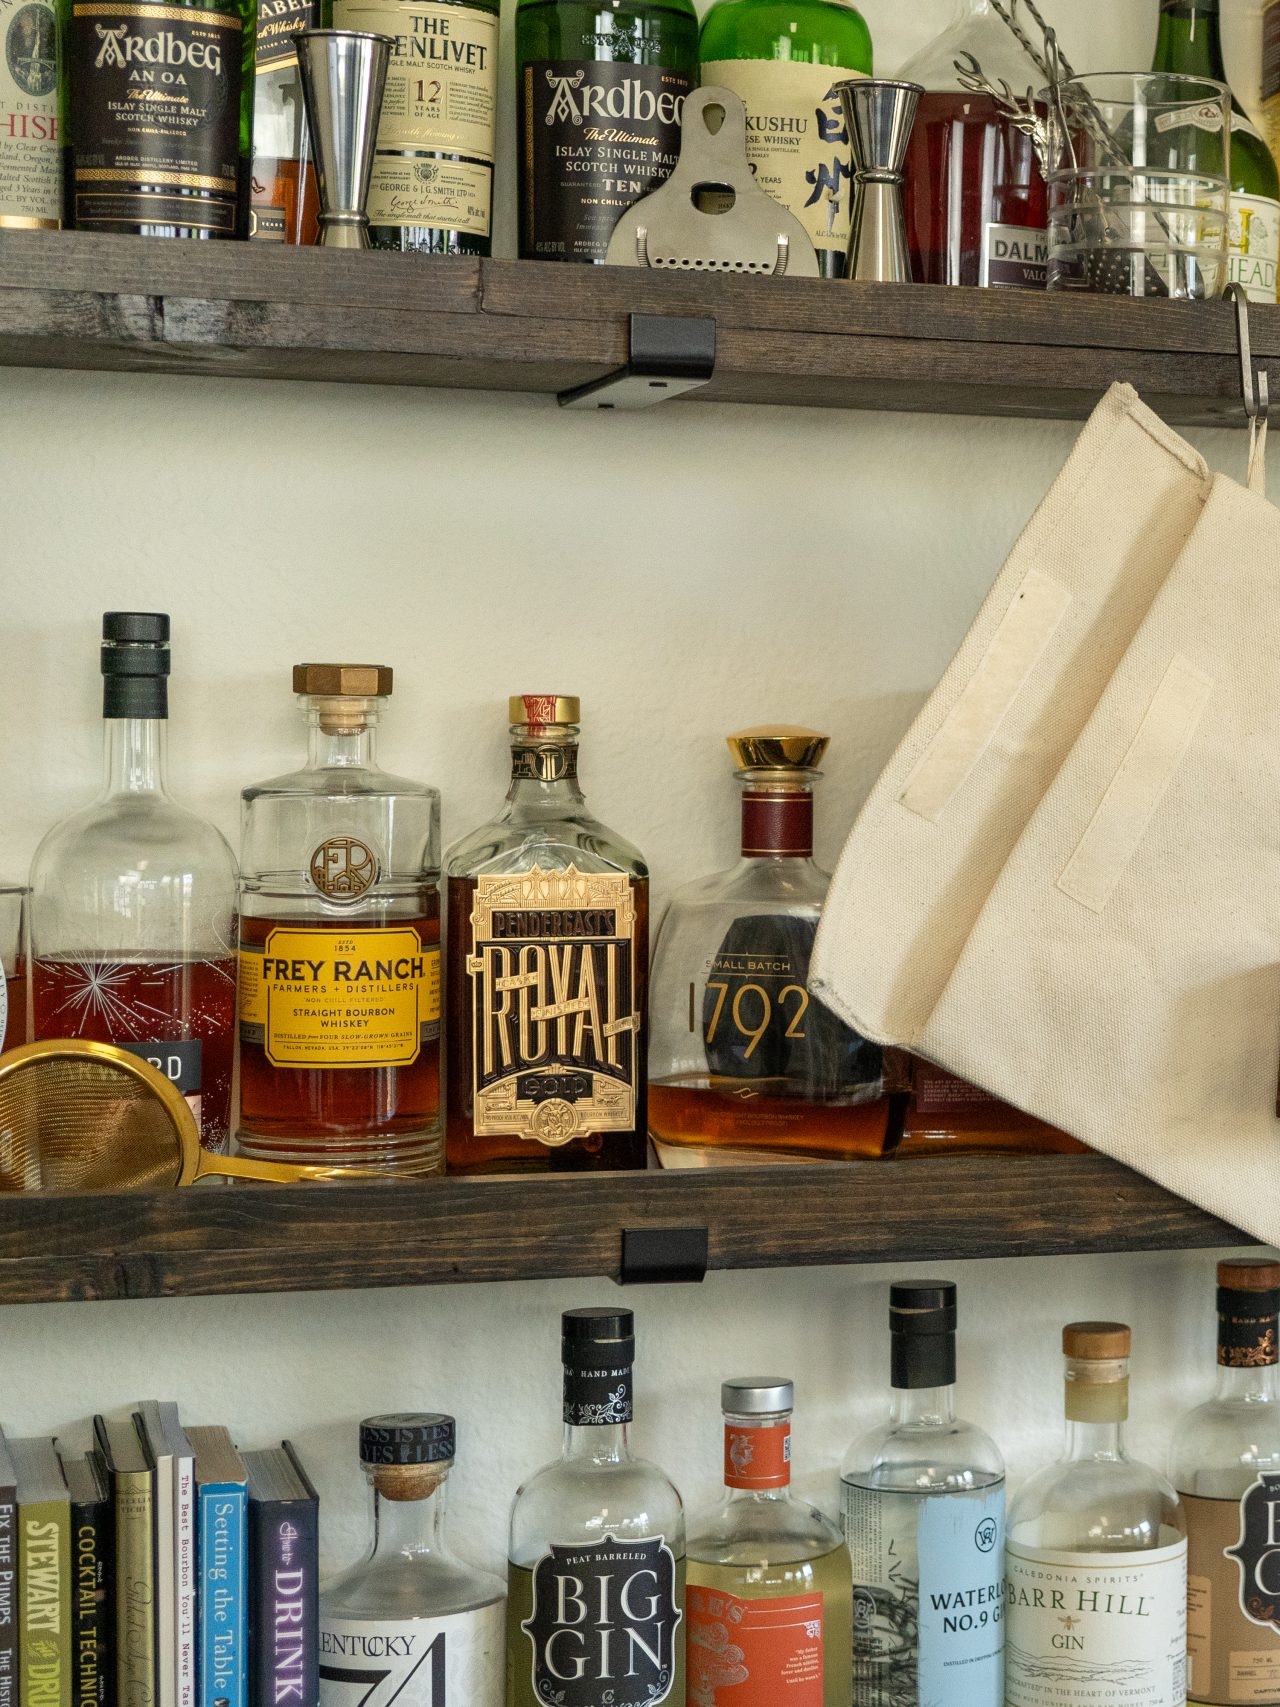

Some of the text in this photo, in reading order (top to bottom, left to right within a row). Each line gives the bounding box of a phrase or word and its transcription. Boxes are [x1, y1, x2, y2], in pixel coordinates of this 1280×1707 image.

[257, 0, 314, 17] ABEL
[409, 16, 450, 36] THE
[129, 70, 187, 85] AN OA
[427, 63, 453, 72] SCOTCH
[454, 66, 476, 75] WHISKY
[415, 79, 443, 104] 12
[108, 101, 207, 117] ISLAY SINGLE MALT
[115, 113, 199, 126] SCOTCH WHISKY
[745, 116, 808, 134] KUSHU
[584, 128, 660, 146] The Ultimate
[764, 136, 801, 146] WHISKY
[556, 146, 680, 165] ISLAY SINGLE MALT
[566, 162, 672, 179] SCOTCH WHISKY
[380, 183, 411, 193] GEORGE
[433, 186, 455, 196] SMITH
[602, 178, 642, 194] TEN
[581, 197, 599, 205] NON
[994, 240, 1048, 262] DALM
[1023, 269, 1047, 281] VALO
[494, 910, 616, 937] PENDERGAST'S
[262, 957, 424, 982] FREY RANCH
[705, 959, 791, 971] SMALL BATCH
[273, 983, 415, 993] FARMERS DISTILLERS
[293, 1008, 395, 1018] STRAIGHT BOURBON
[483, 942, 625, 1077] ROYAL
[320, 1019, 370, 1028] WHISKEY
[688, 981, 810, 1059] 1792
[524, 1076, 588, 1096] GOLD
[581, 1370, 607, 1378] HAND
[419, 1424, 450, 1441] YES
[566, 1551, 648, 1565] PEAT BARRELED
[26, 1520, 61, 1635] STEWART
[78, 1526, 97, 1620] COCKTAIL
[181, 1475, 190, 1677] The Best Bourbon You'll Never
[1014, 1565, 1138, 1584] CALEDONIA SPIRITS
[207, 1503, 234, 1689] Setting the Table
[552, 1569, 662, 1625] BIG
[1008, 1583, 1150, 1616] BARR HILL
[943, 1610, 988, 1633] NO.9
[274, 1567, 304, 1704] DRINK
[1051, 1633, 1085, 1650] GIN
[320, 1634, 416, 1658] ENTUCKY
[544, 1620, 665, 1681] GIN
[1055, 1688, 1070, 1696] THE
[1074, 1688, 1101, 1697] HEART
[1105, 1689, 1117, 1697] OF
[1119, 1685, 1156, 1697] VERMONT
